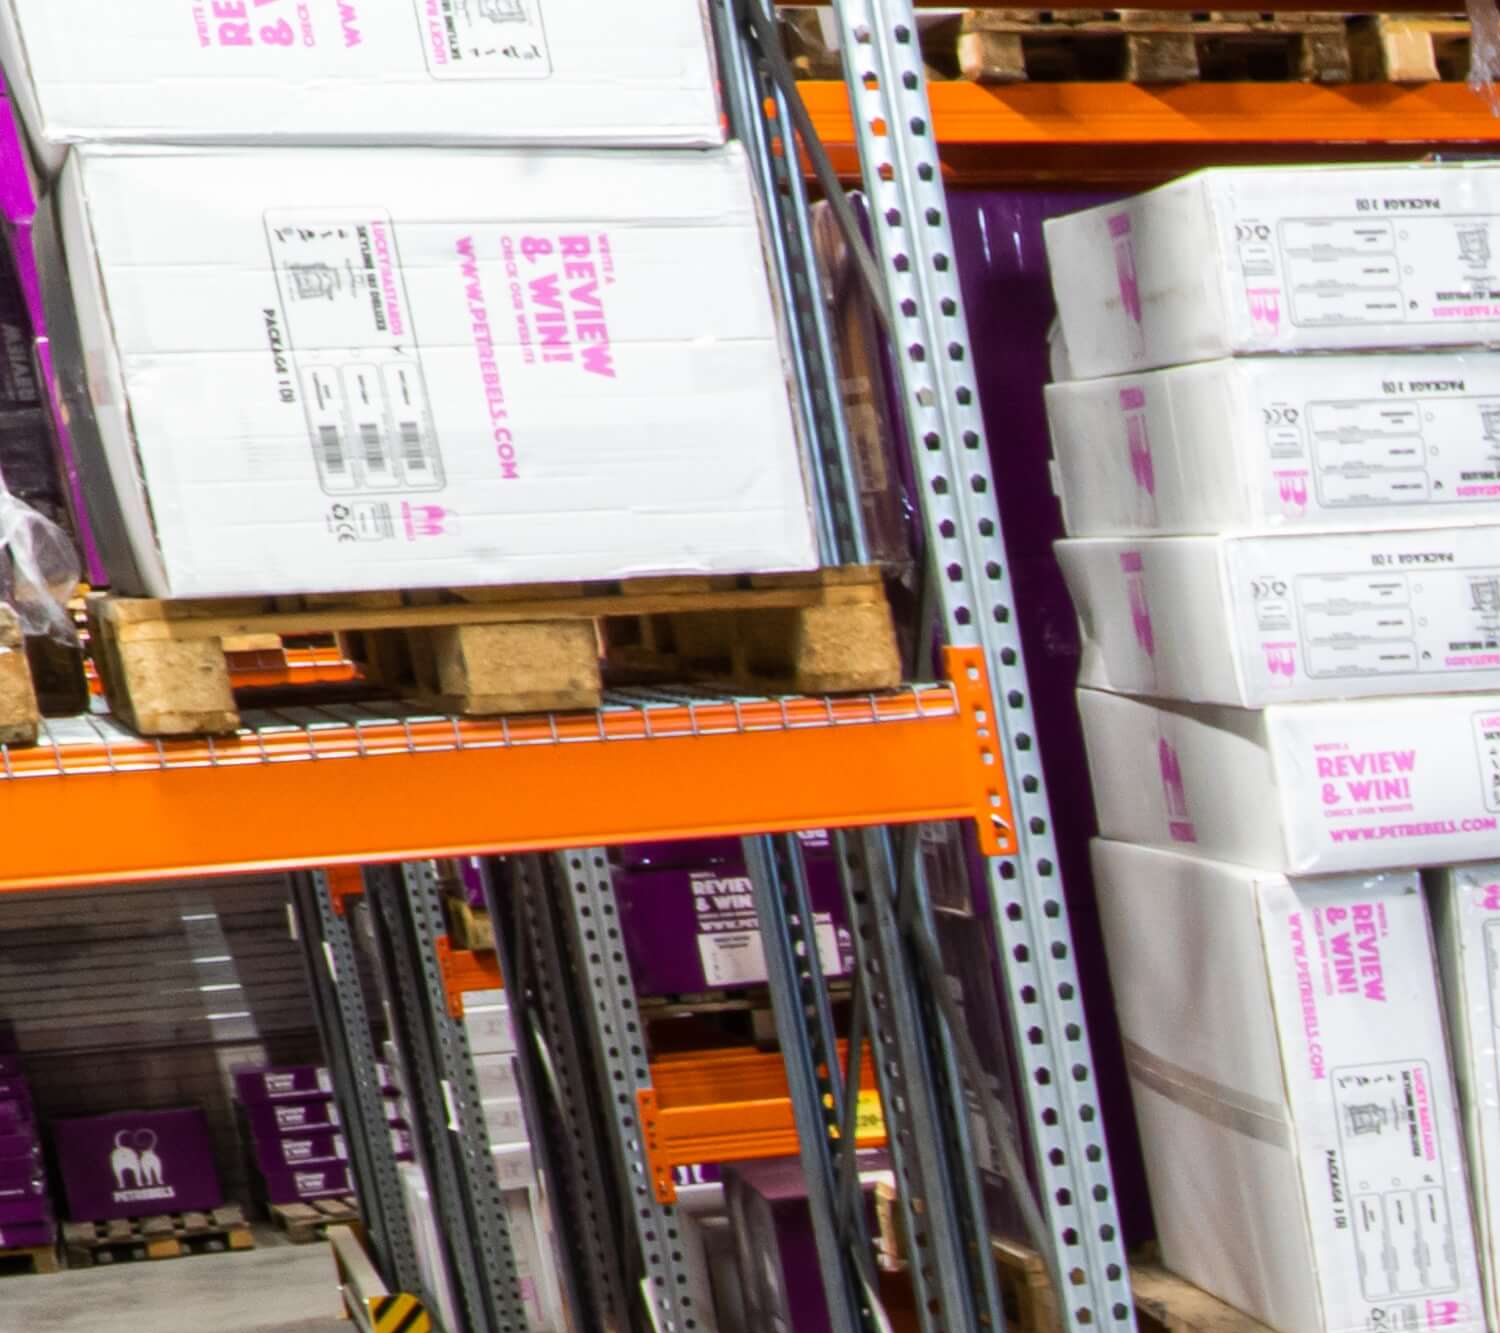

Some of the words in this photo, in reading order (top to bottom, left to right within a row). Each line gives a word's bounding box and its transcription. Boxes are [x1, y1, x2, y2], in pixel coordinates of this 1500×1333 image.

[520, 235, 553, 263] &
[528, 273, 573, 362] WIN!
[559, 234, 614, 378] REVIEW
[263, 309, 288, 373] PACKAGE
[455, 235, 517, 480] WWW.PETREBELS.COM
[1316, 751, 1415, 782] REVIEW
[1321, 783, 1339, 805] &
[1349, 778, 1408, 801] WIN!
[1324, 906, 1347, 925] &
[1331, 932, 1358, 992] WIN!
[1348, 903, 1385, 1001] REVIEW
